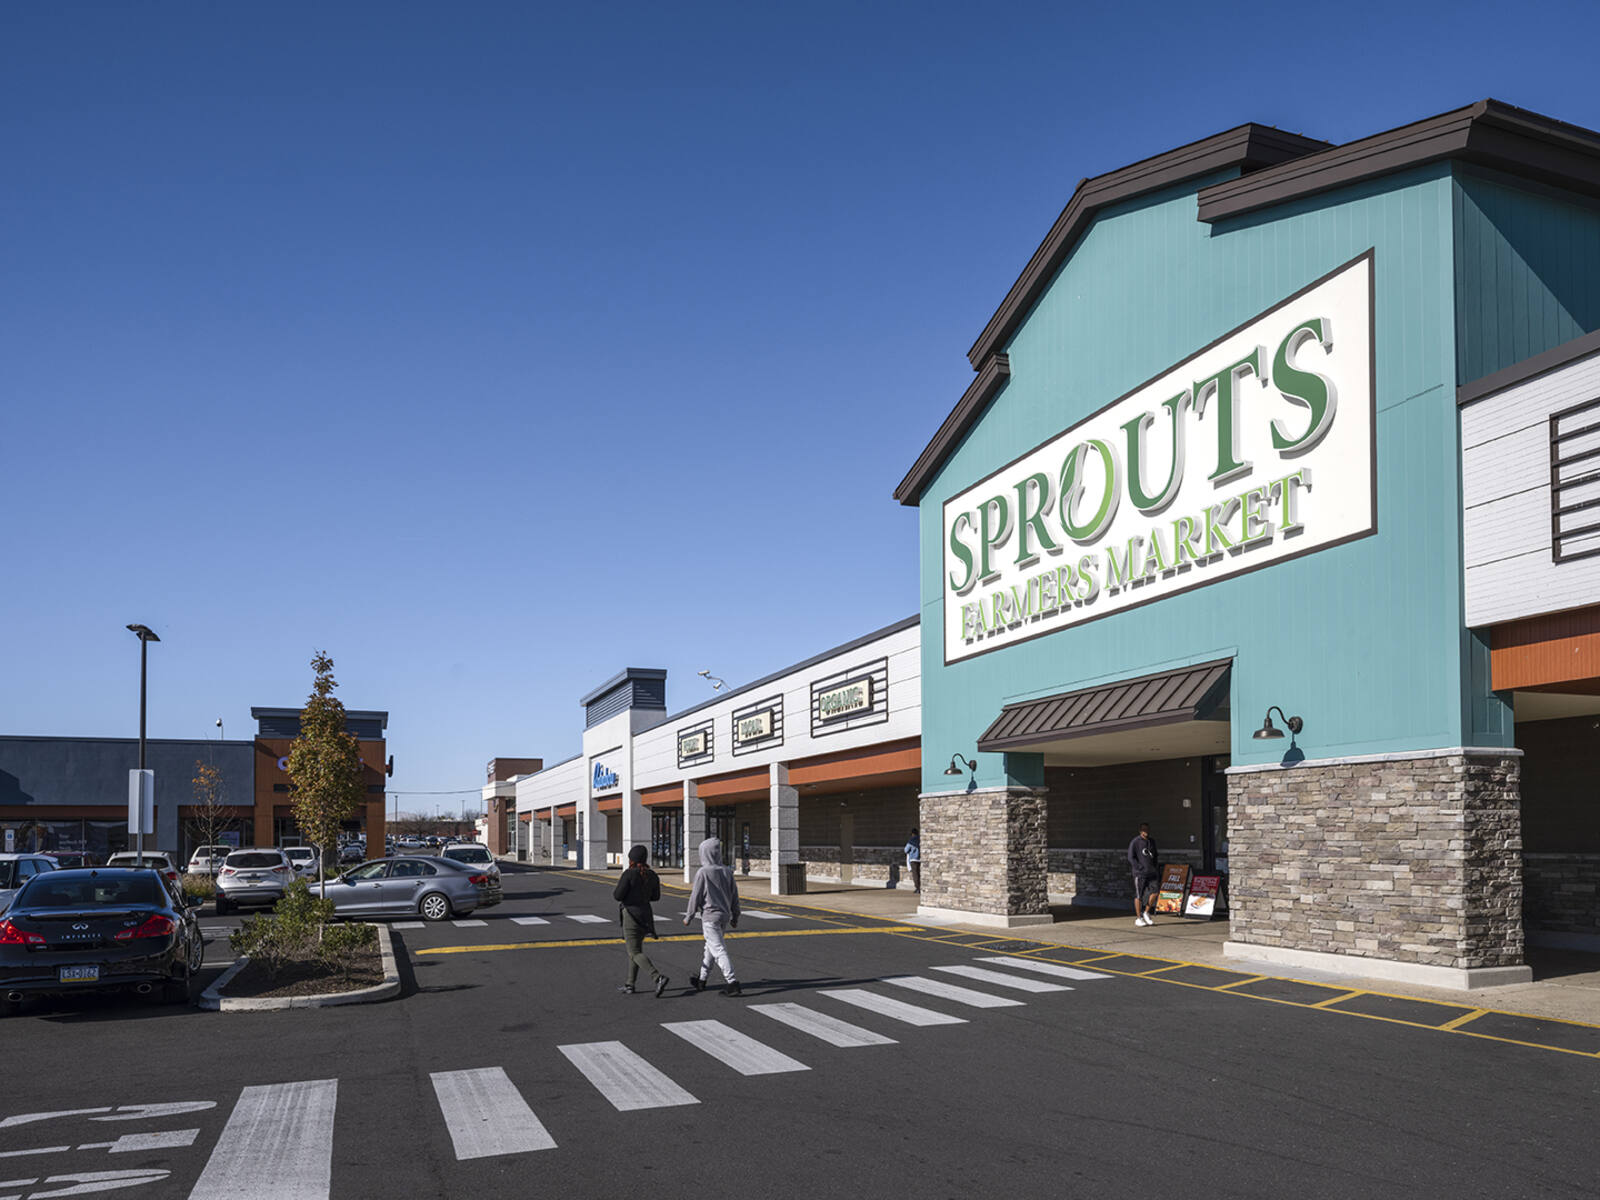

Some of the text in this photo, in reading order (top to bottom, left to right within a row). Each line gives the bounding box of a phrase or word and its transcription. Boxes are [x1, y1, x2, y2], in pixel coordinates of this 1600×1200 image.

[949, 316, 1338, 595] SPROUTS
[960, 467, 1312, 644] FARMERS MARKET
